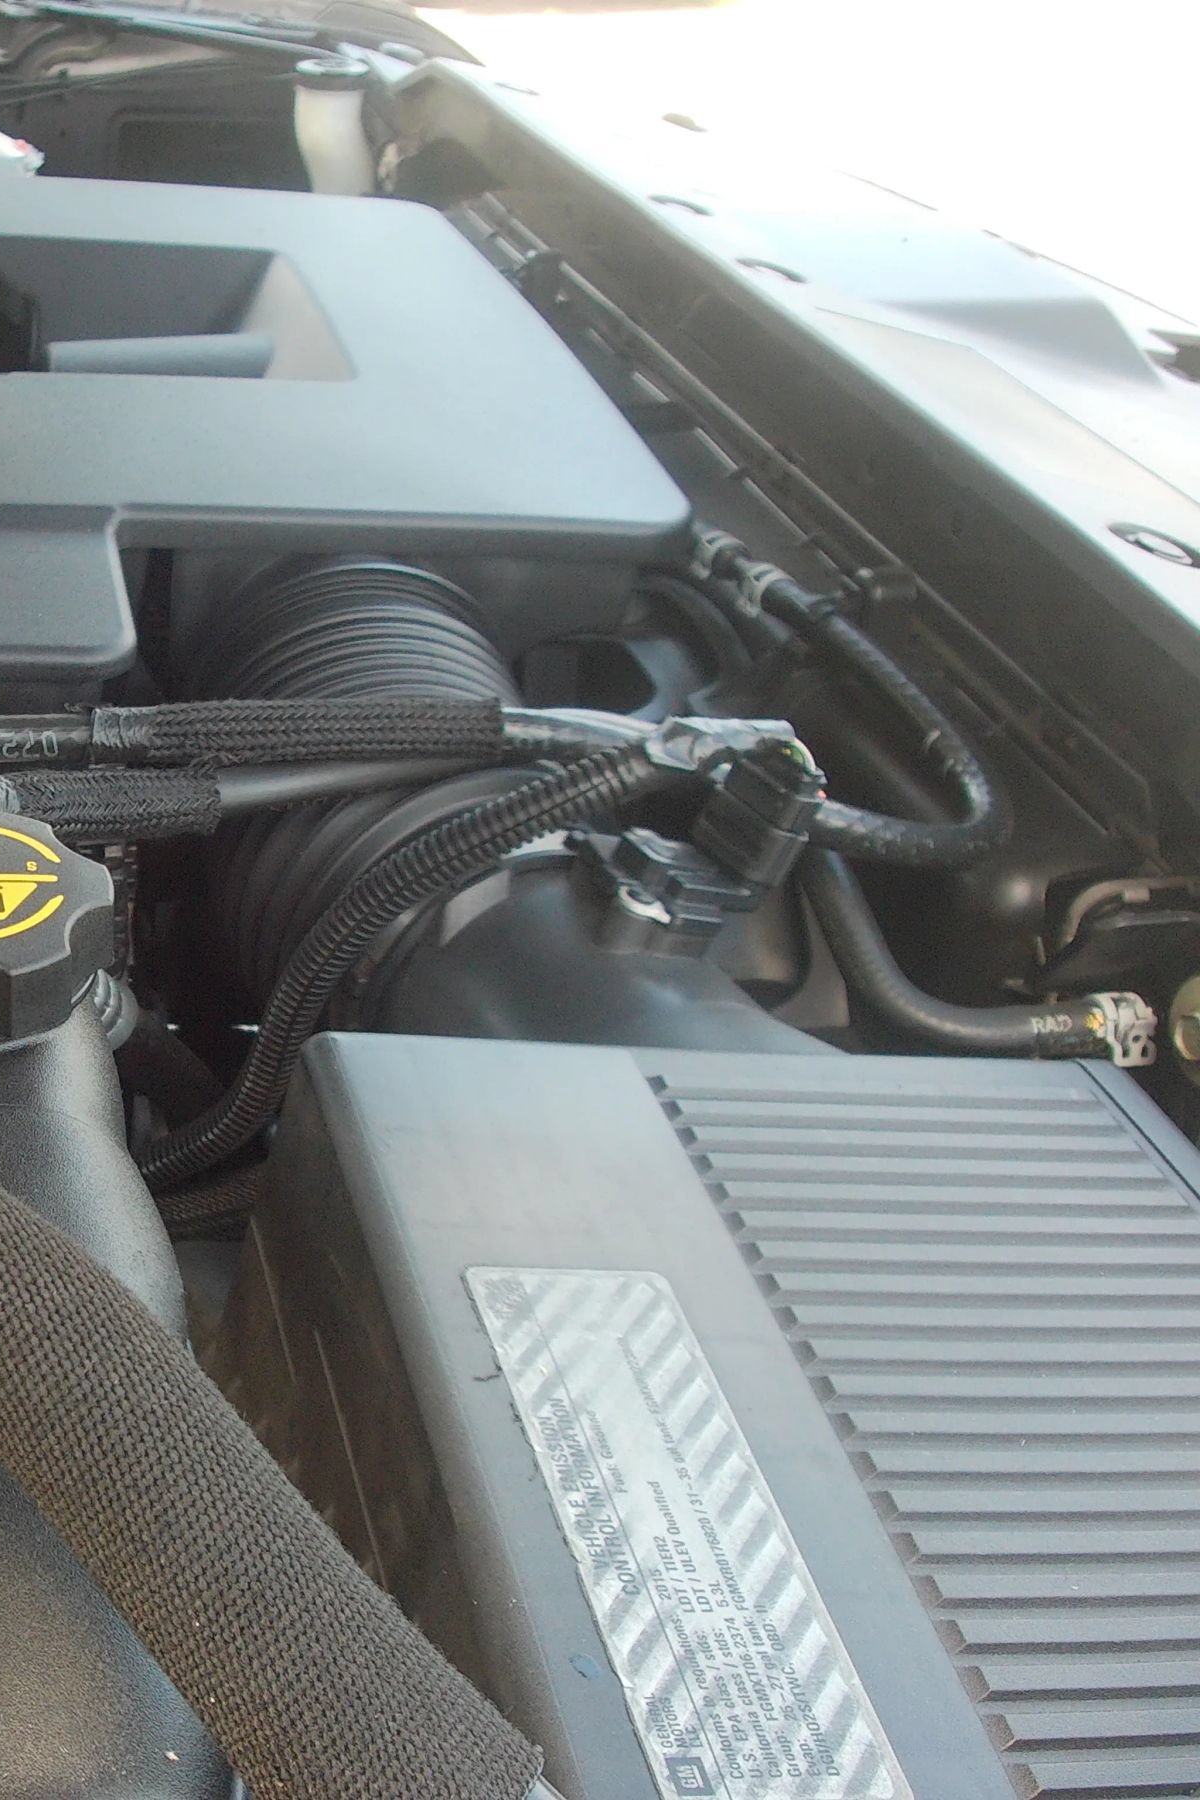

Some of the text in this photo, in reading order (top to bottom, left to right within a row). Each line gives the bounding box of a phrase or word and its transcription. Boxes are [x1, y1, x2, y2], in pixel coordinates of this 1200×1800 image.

[1031, 1014, 1073, 1033] RAD
[535, 1415, 612, 1570] VEHICLE EMISSION
[603, 1462, 629, 1493] Fuel:
[547, 1396, 642, 1595] CONTROL INFORMATION
[645, 1480, 682, 1535] Qualified
[651, 1534, 679, 1571] TIER2
[670, 1538, 698, 1573] ULEV
[672, 1586, 696, 1613] LDT
[690, 1586, 715, 1613] LDT
[705, 1578, 731, 1607] 5.3L
[690, 1629, 716, 1660] stds:
[707, 1626, 734, 1658] stds:
[739, 1615, 766, 1646] tank:
[646, 1568, 746, 1779] Conforms to regulations: 2015
[754, 1649, 778, 1669] gal
[709, 1675, 736, 1709] class
[727, 1672, 754, 1706] class
[641, 1692, 674, 1748] GENERAL
[657, 1695, 690, 1748] MOTORS
[683, 1724, 704, 1747] LLC
[724, 1713, 750, 1741] EPA
[742, 1710, 785, 1778] California
[769, 1728, 806, 1777] Group:
[793, 1737, 826, 1776] Evap:
[673, 1764, 699, 1788] GM
[739, 1747, 765, 1778] U.S.
